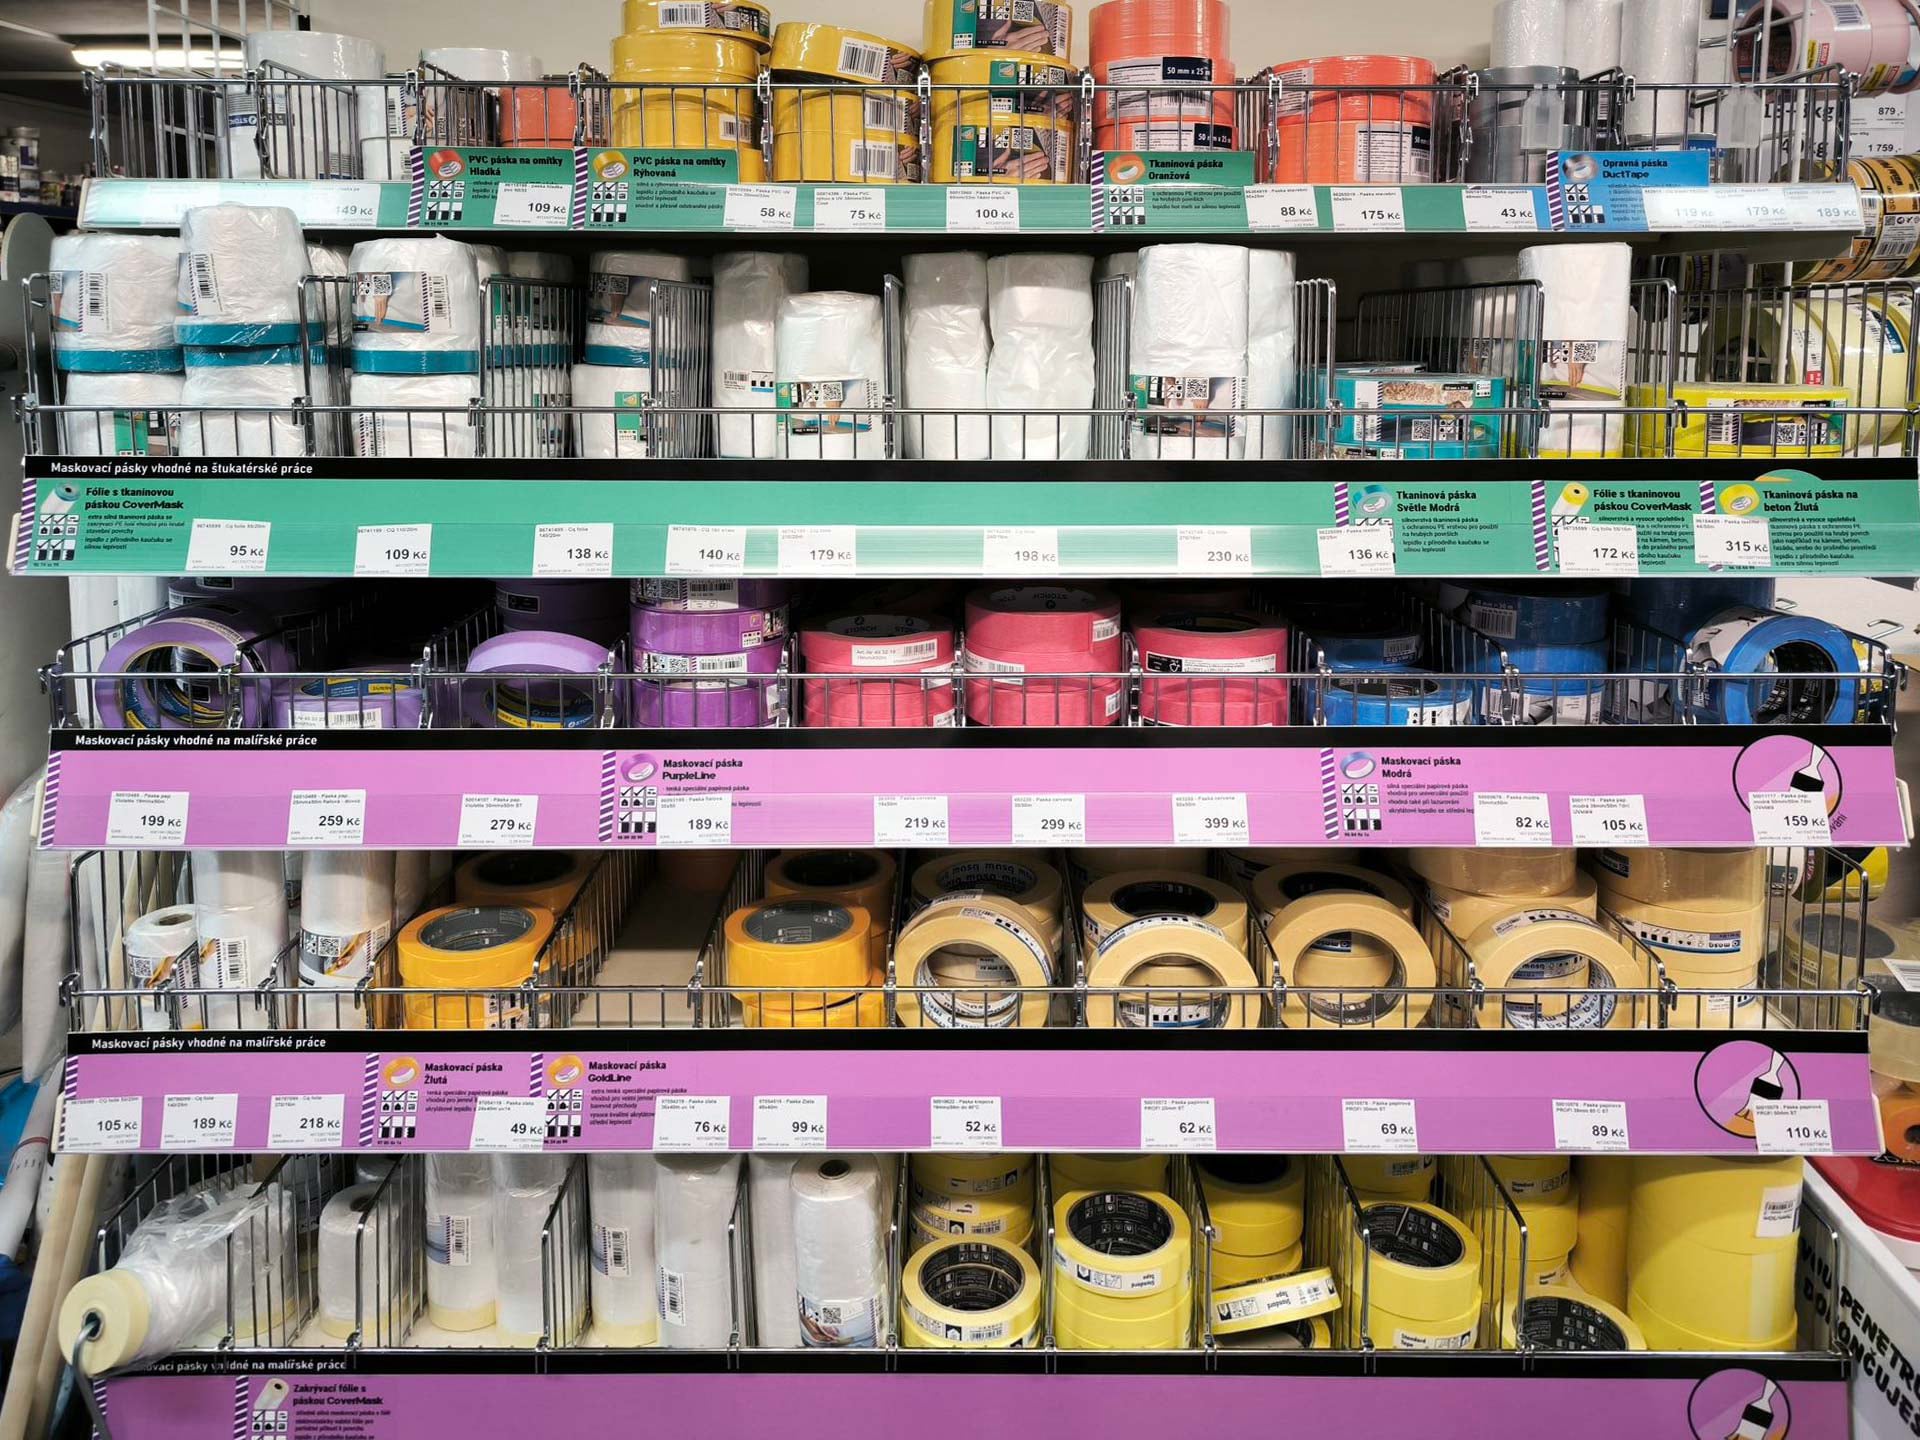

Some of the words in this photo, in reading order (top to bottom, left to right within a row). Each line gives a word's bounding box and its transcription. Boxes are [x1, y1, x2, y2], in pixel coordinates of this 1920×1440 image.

[1878, 107, 1896, 116] 879
[468, 155, 488, 164] PVC
[491, 155, 517, 166] páska
[532, 156, 563, 167] omítky
[633, 156, 652, 165] PVC
[654, 156, 681, 167] páska
[696, 157, 726, 168] omítky
[1149, 159, 1195, 169] Tkaninová
[1197, 159, 1223, 170] páska
[1603, 159, 1639, 169] Opravná
[1641, 159, 1668, 169] páska
[470, 167, 501, 176] Hladká
[633, 168, 676, 179] Rýhovaná
[1148, 171, 1190, 180] Oranžová
[1602, 170, 1649, 179] DuctTape
[528, 203, 550, 213] 109
[760, 207, 775, 217] 58
[976, 209, 998, 218] 100
[1281, 206, 1296, 216] 88
[1501, 208, 1516, 217] 43
[850, 210, 866, 219] 75
[1361, 210, 1384, 220] 175
[51, 462, 112, 473] Maskovací
[114, 462, 148, 475] pásky
[151, 462, 191, 473] vhodné
[195, 465, 208, 473] na
[211, 462, 278, 473] štukatérské
[281, 462, 313, 476] práce
[86, 487, 110, 496] Fólie
[121, 487, 174, 496] tkaninovou
[1396, 490, 1445, 499] Tkaninová
[1448, 490, 1476, 501] páska
[1593, 489, 1617, 498] Fólie
[1627, 489, 1680, 498] tkaninovou
[1763, 490, 1813, 499] Tkaninová
[1815, 490, 1844, 501] páska
[85, 500, 120, 510] páskou
[122, 500, 184, 509] CoverMask
[1397, 503, 1427, 512] Světle
[1429, 503, 1460, 512] Modrá
[1594, 501, 1629, 512] páskou
[1631, 502, 1692, 511] CoverMask
[1764, 503, 1791, 511] beton
[1794, 501, 1819, 511] Žlutá
[230, 545, 247, 556] 95
[1726, 540, 1751, 552] 315
[1754, 544, 1768, 552] Kč
[385, 549, 409, 560] 109
[567, 548, 591, 559] 138
[1348, 549, 1373, 559] 136
[1376, 551, 1388, 559] Kč
[1593, 548, 1618, 558] 172
[1621, 551, 1635, 559] Kč
[75, 734, 135, 745] Maskovací
[137, 734, 170, 747] pásky
[173, 734, 213, 745] vhodné
[217, 737, 230, 745] na
[234, 734, 283, 745] malířské
[286, 734, 317, 747] práce
[663, 759, 713, 768] Maskovací
[715, 759, 743, 769] páska
[1381, 756, 1431, 765] Maskovací
[1433, 756, 1461, 767] páska
[662, 771, 716, 781] PurpleLine
[1382, 769, 1412, 778] Modrá
[141, 815, 165, 826] 199
[168, 819, 181, 827] Kč
[319, 815, 343, 826] 259
[347, 818, 360, 826] Kč
[490, 819, 515, 830] 279
[1516, 817, 1532, 828] 82
[1536, 820, 1549, 828] Kč
[1602, 820, 1626, 831] 105
[1784, 815, 1808, 826] 159
[1812, 818, 1825, 826] Kč
[92, 1037, 150, 1049] Maskovací
[152, 1037, 184, 1050] pásky
[188, 1036, 226, 1047] vhodné
[229, 1039, 242, 1047] na
[246, 1036, 293, 1047] malířské
[296, 1036, 326, 1049] práce
[425, 1063, 474, 1071] Maskovací
[476, 1063, 503, 1073] páska
[589, 1061, 637, 1070] Maskovací
[639, 1060, 666, 1071] páska
[424, 1074, 447, 1084] Žlutá
[588, 1074, 632, 1082] GoldLine
[98, 1119, 121, 1131] 105
[124, 1122, 137, 1130] Kč
[193, 1117, 216, 1129] 189
[219, 1120, 232, 1128] Kč
[300, 1117, 324, 1129] 218
[327, 1120, 340, 1128] Kč
[695, 1121, 710, 1133] 76
[713, 1125, 726, 1133] Kč
[792, 1121, 808, 1133] 99
[811, 1125, 824, 1133] Kč
[966, 1121, 981, 1132] 52
[984, 1124, 996, 1132] Kč
[1179, 1122, 1195, 1133] 62
[1381, 1123, 1397, 1134] 69
[510, 1123, 527, 1134] 49
[530, 1127, 542, 1135] Kč
[1592, 1125, 1608, 1137] 89
[1611, 1129, 1624, 1137] Kč
[1787, 1127, 1810, 1138] 110
[1814, 1130, 1827, 1138] Kč
[177, 1361, 208, 1373] pásky
[252, 1362, 265, 1370] na
[268, 1359, 314, 1370] malířské
[293, 1384, 337, 1394] Zakrývací
[339, 1384, 359, 1393] fólie
[293, 1396, 325, 1407] páskou
[327, 1397, 383, 1405] CoverMask
